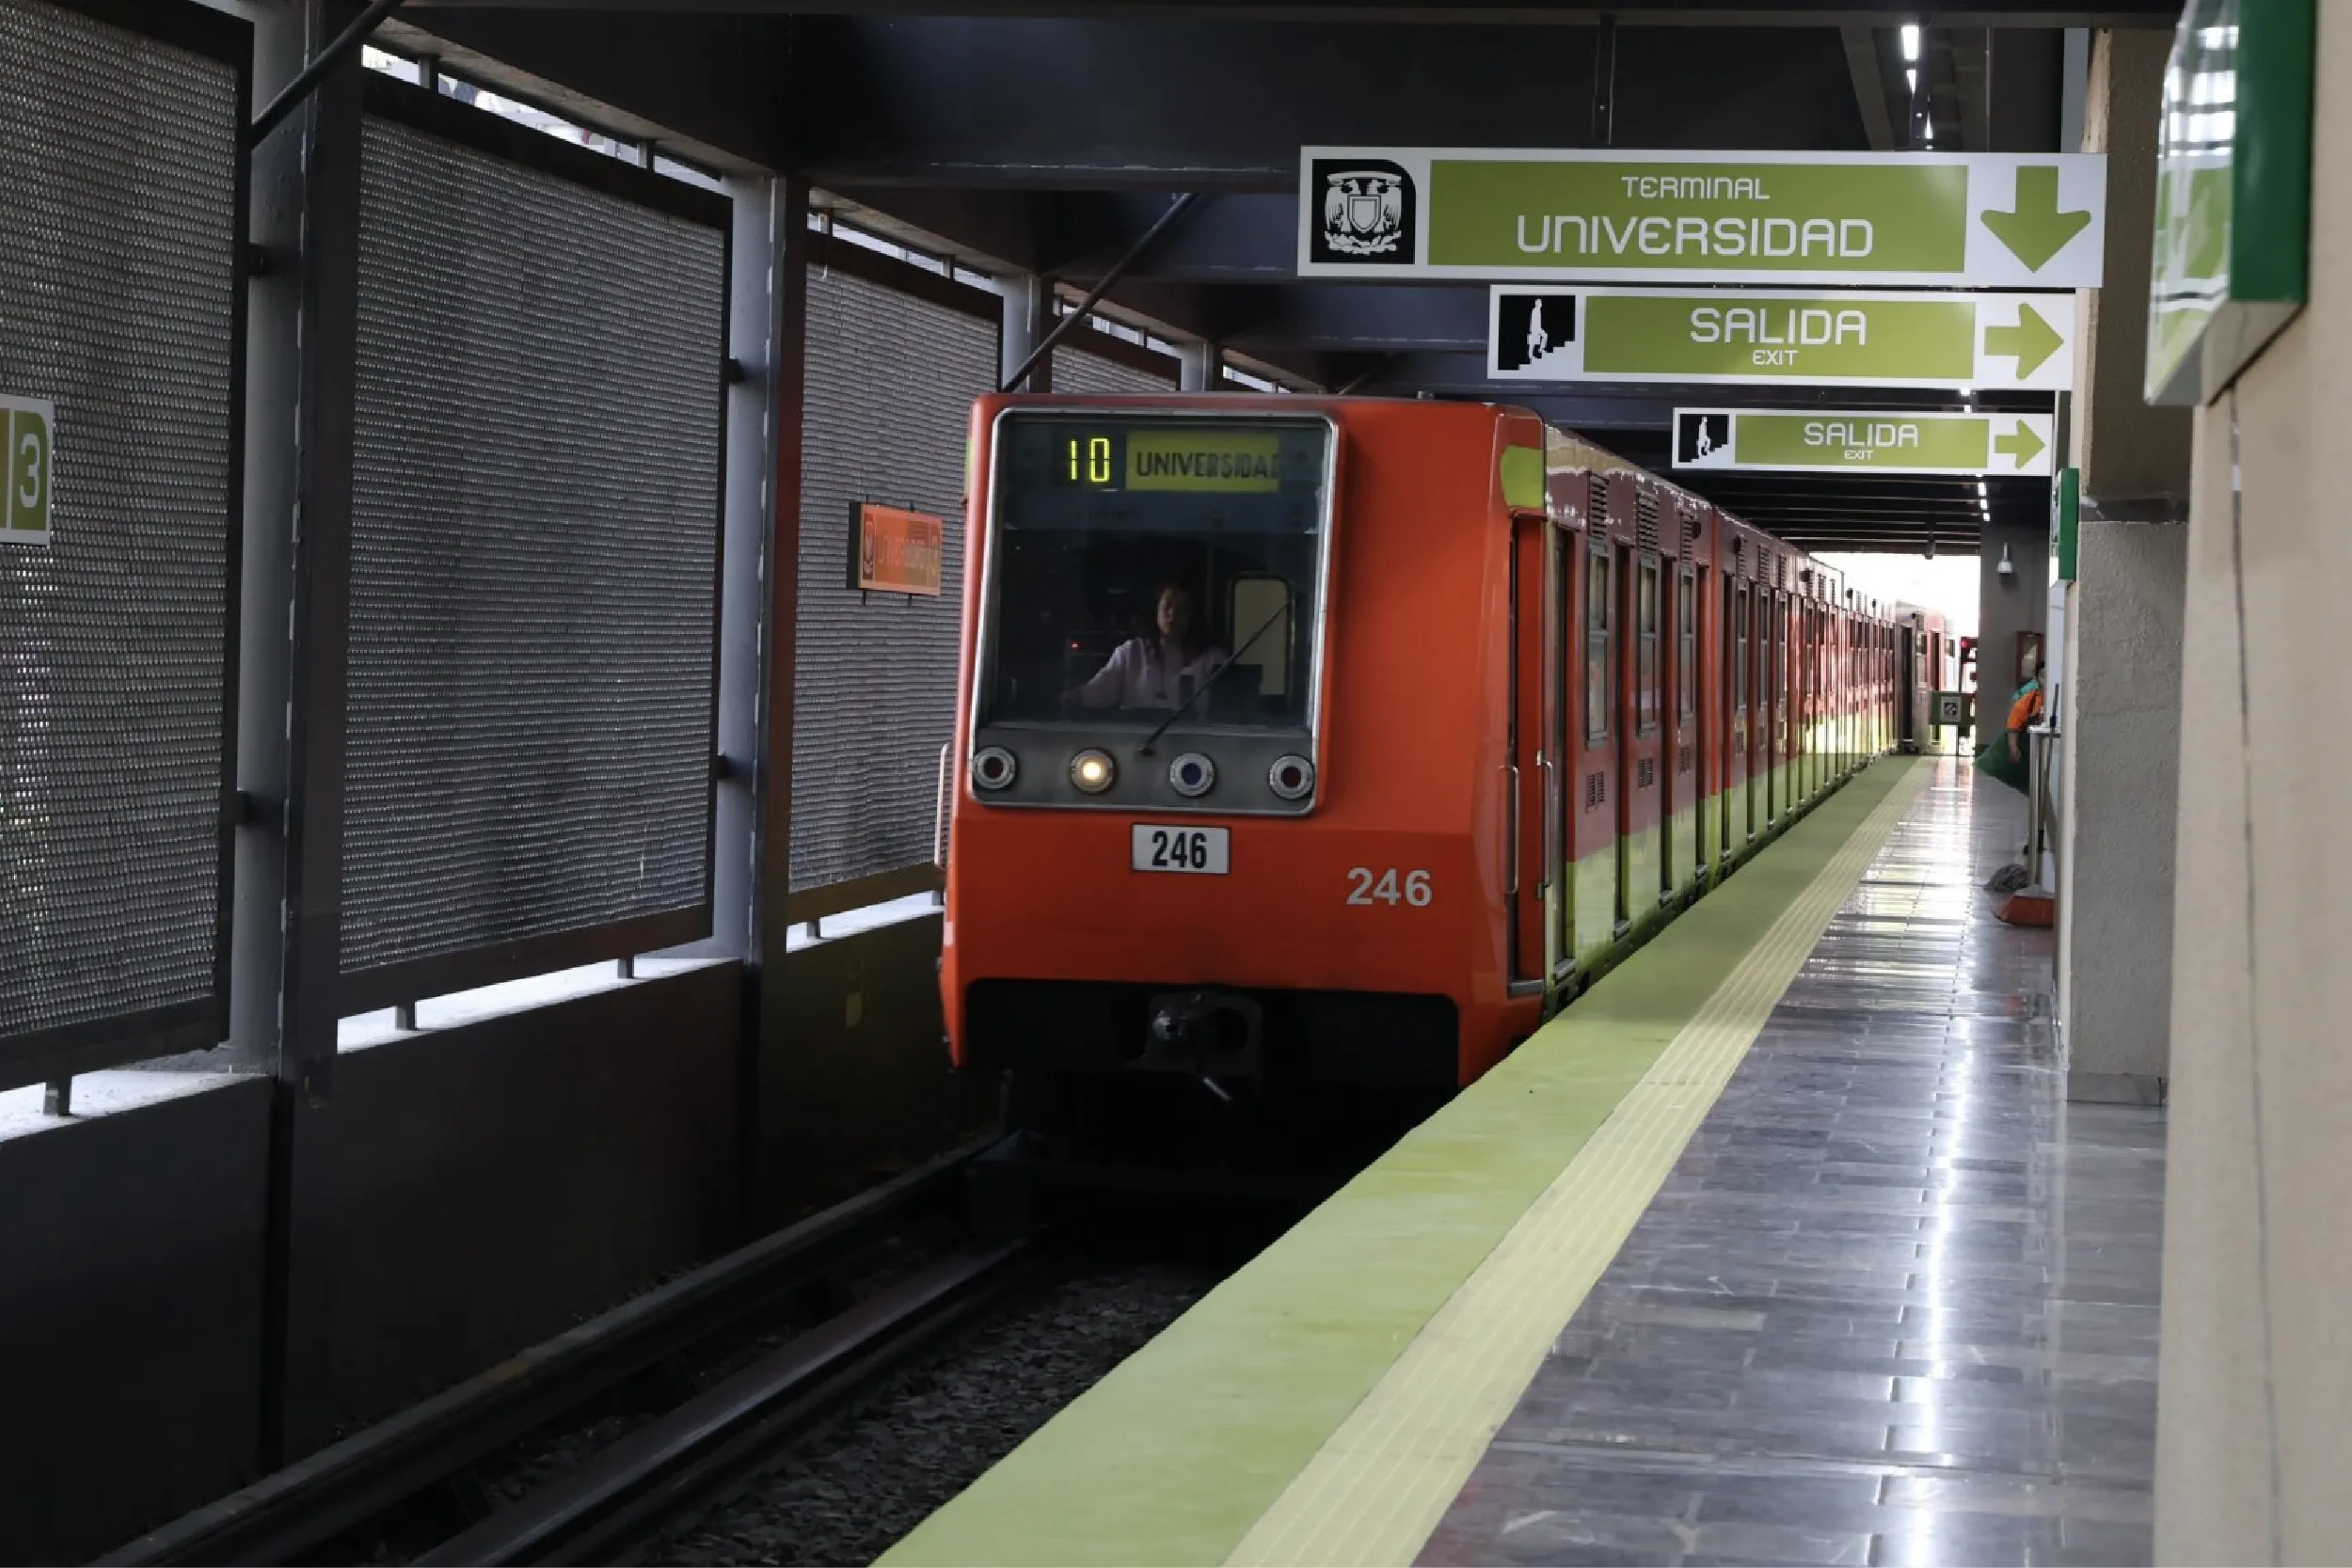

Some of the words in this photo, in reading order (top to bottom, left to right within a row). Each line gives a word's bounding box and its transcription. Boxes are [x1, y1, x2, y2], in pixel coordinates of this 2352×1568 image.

[1621, 176, 1771, 199] TERMINAL
[1517, 215, 1874, 257] UNIVERSIDAD
[1690, 308, 1867, 345] SALIDA
[1752, 349, 1799, 366] EXIT
[1804, 421, 1919, 448] SALIDA
[20, 433, 40, 509] 3
[1069, 437, 1110, 483] 10
[1844, 450, 1874, 460] EXIT
[1152, 830, 1207, 869] 246
[1345, 867, 1433, 907] 246
